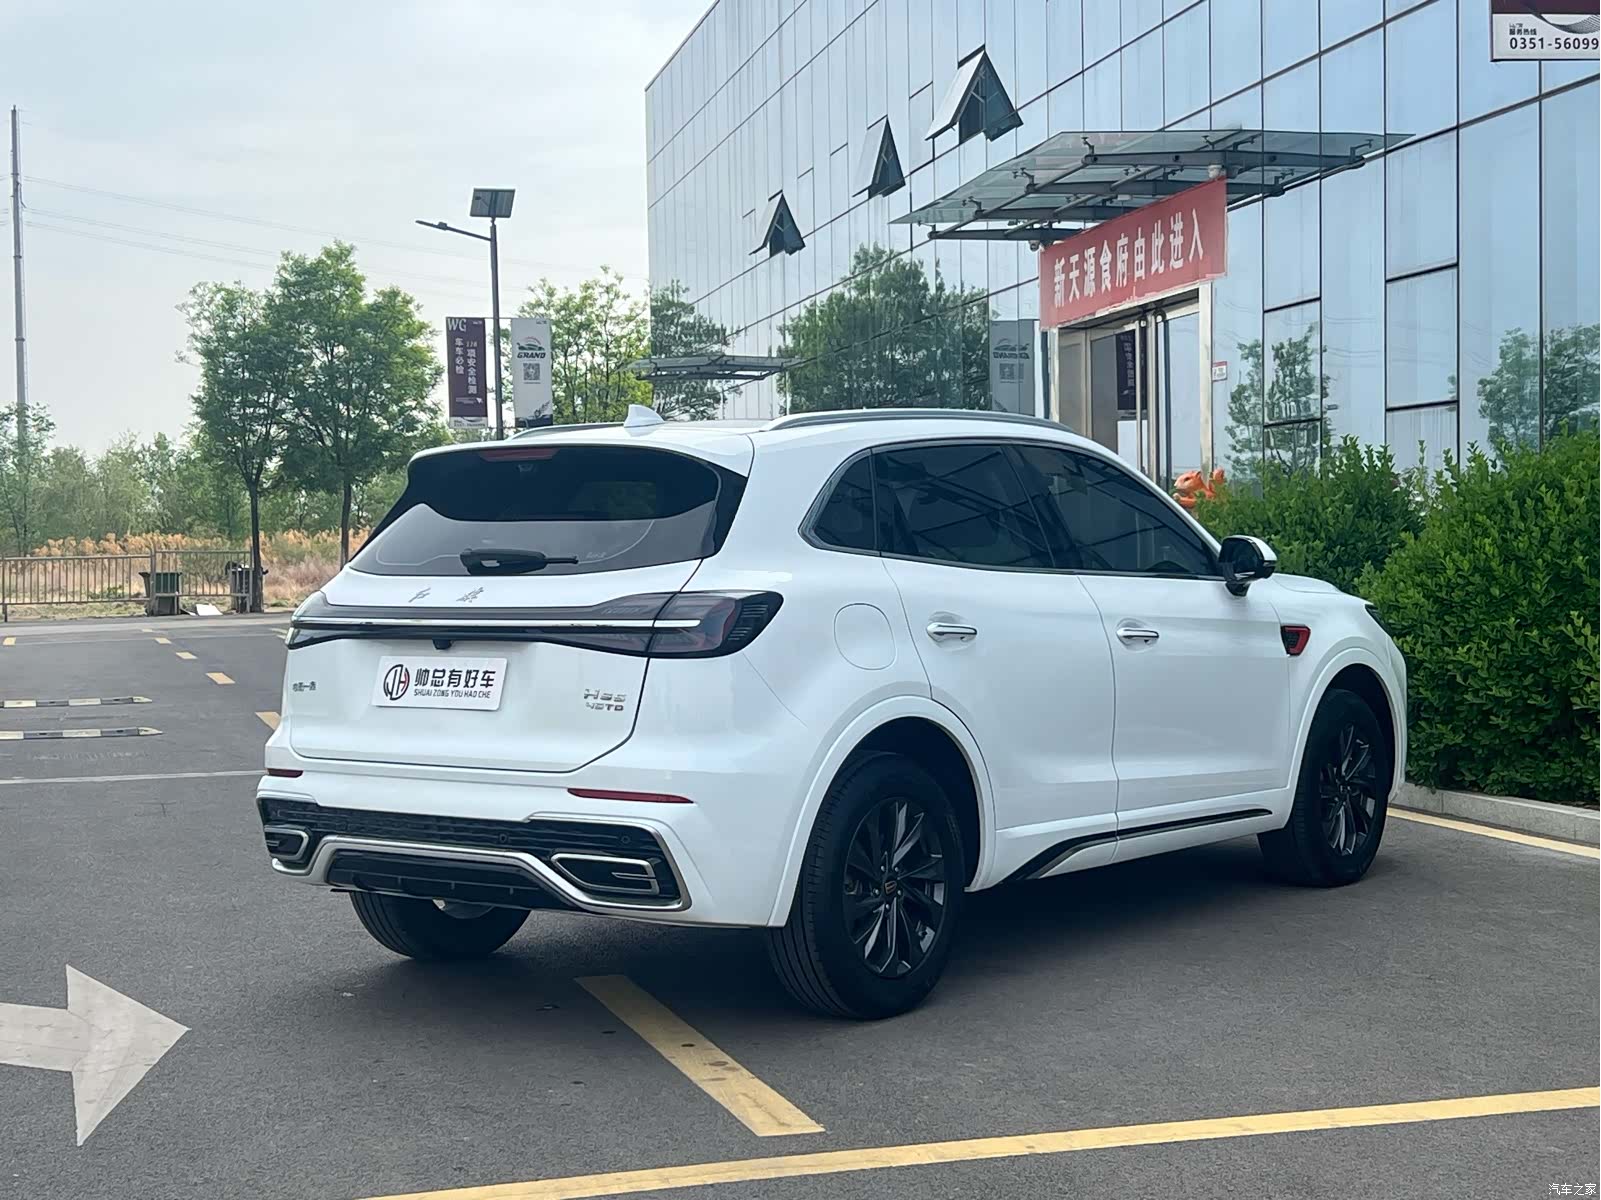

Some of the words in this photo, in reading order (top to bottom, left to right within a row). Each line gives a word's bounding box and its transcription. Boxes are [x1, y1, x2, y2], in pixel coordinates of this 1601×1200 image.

[1509, 37, 1599, 50] 0351-56099
[1054, 208, 1204, 308] 新天源食府由此进入
[447, 318, 467, 332] WG
[414, 668, 496, 688] 帅总有好车
[414, 689, 432, 697] SHUAI
[433, 689, 449, 697] ZONG
[451, 690, 463, 698] YOU
[464, 690, 477, 698] HAO
[478, 690, 491, 699] CHE
